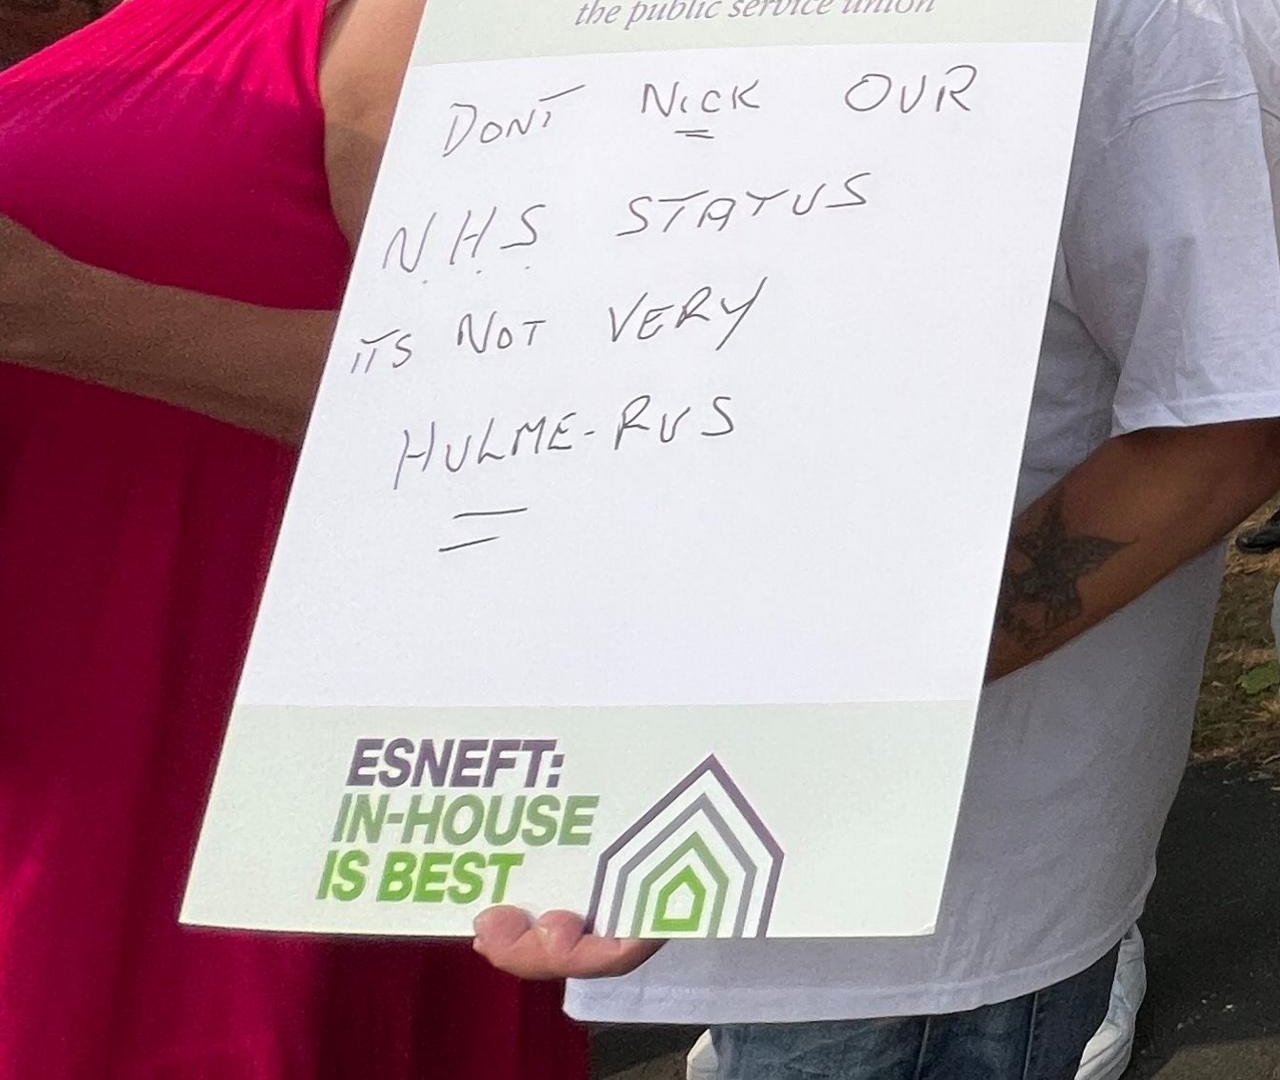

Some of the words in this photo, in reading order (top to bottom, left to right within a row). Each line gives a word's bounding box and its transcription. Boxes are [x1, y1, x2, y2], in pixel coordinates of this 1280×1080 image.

[844, 64, 977, 114] OUR
[616, 172, 872, 237] STATUS
[456, 310, 547, 354] NOT
[608, 276, 769, 352] VERY
[345, 737, 566, 789] ESNEFT:
[331, 792, 601, 847] IN-HOUSE
[315, 849, 370, 902] IS
[375, 850, 526, 904] BEST
